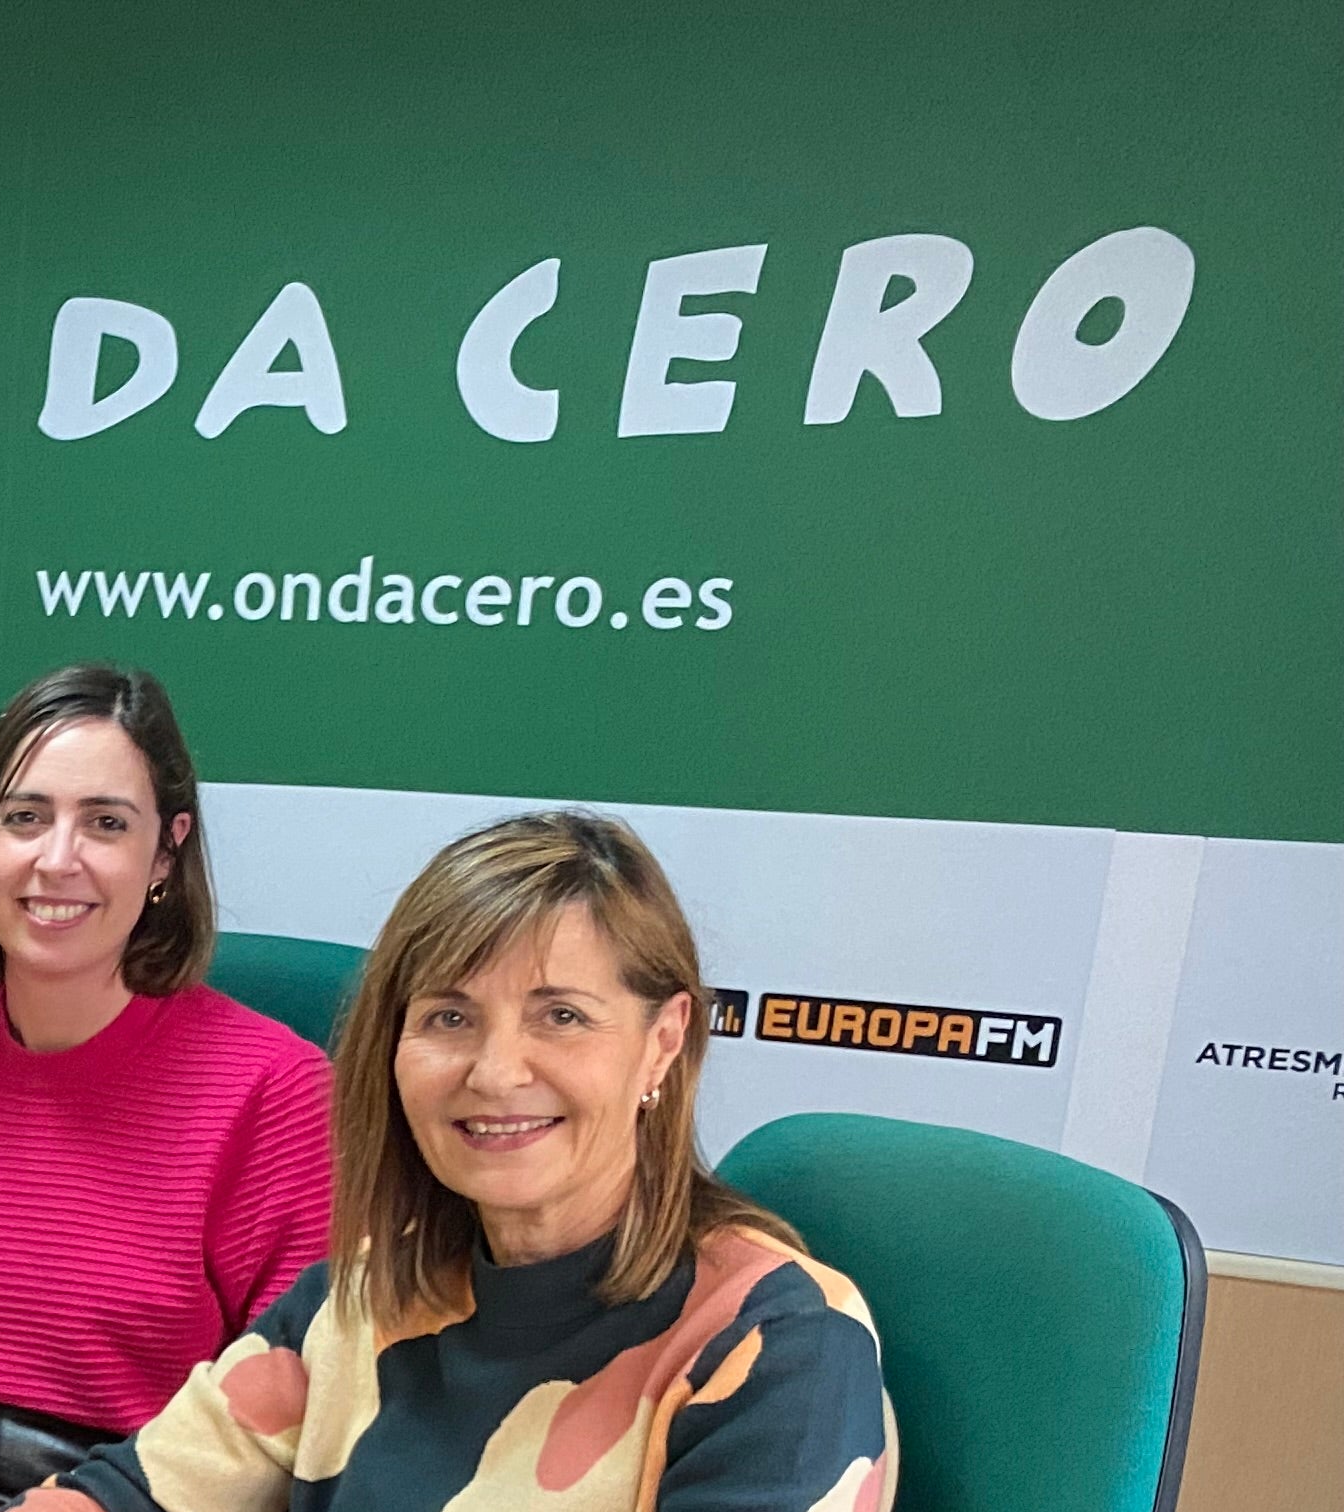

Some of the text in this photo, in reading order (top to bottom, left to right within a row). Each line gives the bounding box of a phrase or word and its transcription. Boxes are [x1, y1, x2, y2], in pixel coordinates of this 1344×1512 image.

[456, 225, 1196, 443] CERO
[37, 555, 734, 631] www.ondacero.es
[1195, 1042, 1344, 1075] ATRESM
